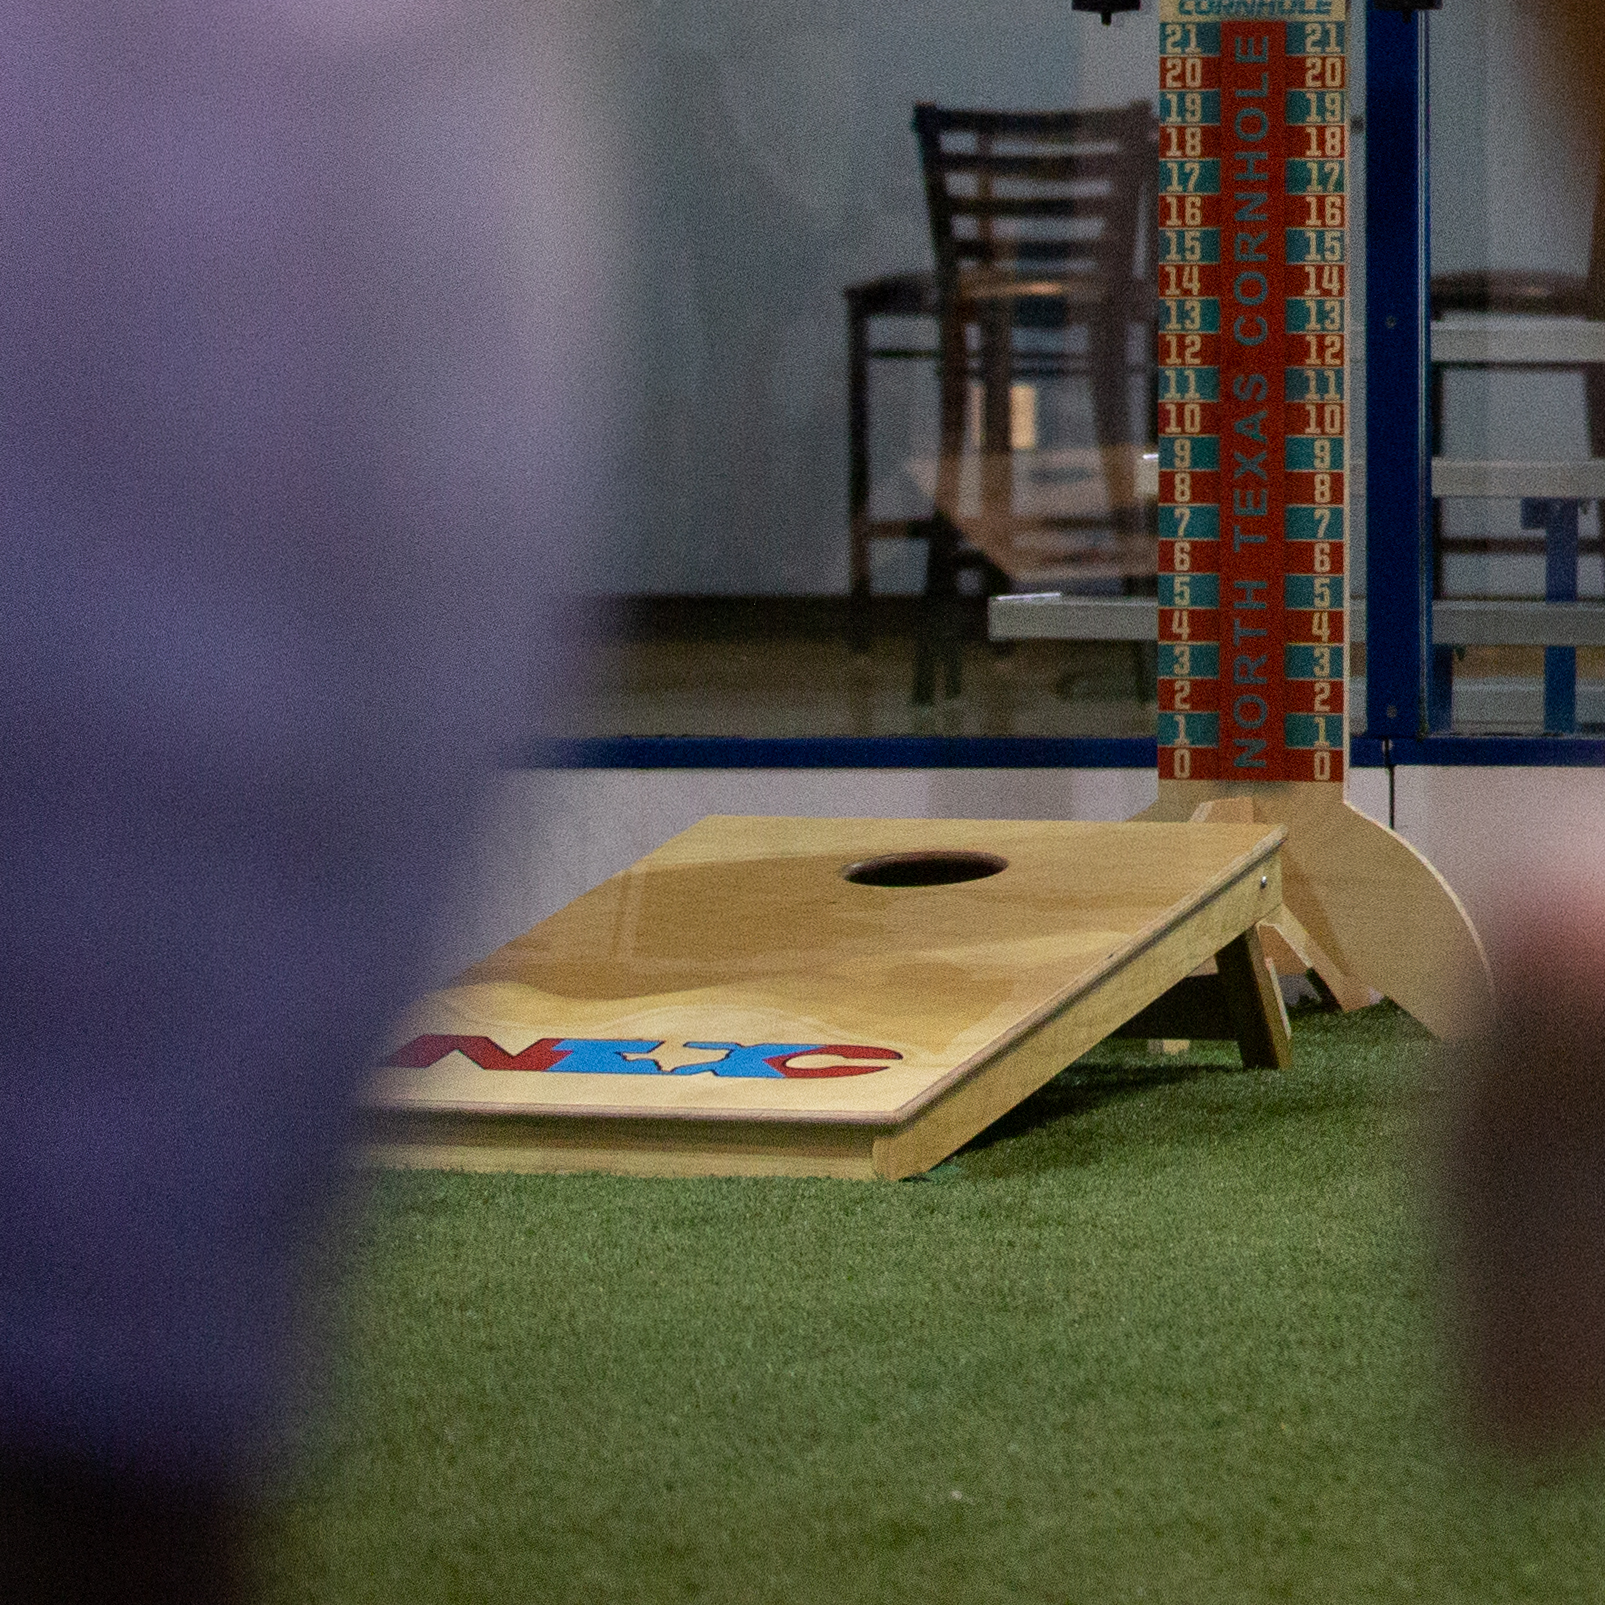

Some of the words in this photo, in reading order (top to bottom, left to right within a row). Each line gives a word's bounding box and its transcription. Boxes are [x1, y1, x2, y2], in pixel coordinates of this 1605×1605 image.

[1165, 25, 1198, 54] 21
[1305, 25, 1339, 54] 21
[1165, 57, 1201, 87] 20
[1305, 57, 1341, 87] 20
[1165, 93, 1201, 122] 19
[1305, 93, 1341, 122] 19
[1165, 127, 1201, 157] 18
[1305, 127, 1341, 157] 18
[1165, 162, 1200, 192] 17
[1234, 36, 1269, 346] CORNHOLE
[1305, 162, 1340, 192] 17
[1165, 196, 1201, 226] 16
[1305, 197, 1341, 227] 16
[1165, 231, 1201, 261] 15
[1305, 232, 1341, 262] 15
[1165, 266, 1201, 296] 14
[1305, 267, 1341, 297] 14
[1165, 300, 1201, 330] 13
[1305, 301, 1341, 331] 13
[1165, 335, 1201, 365] 12
[1305, 336, 1341, 366] 12
[1165, 370, 1198, 400] 11
[1305, 371, 1339, 401] 11
[1165, 404, 1201, 433] 10
[1305, 405, 1341, 434] 10
[1173, 439, 1191, 468] 9
[1233, 374, 1268, 553] TEXAS
[1314, 440, 1330, 469] 9
[1173, 473, 1191, 503] 8
[1314, 475, 1330, 505] 8
[1173, 507, 1191, 536] 7
[1314, 509, 1330, 538] 7
[1173, 541, 1191, 571] 6
[1314, 543, 1330, 573] 6
[1173, 576, 1191, 606] 5
[1314, 578, 1330, 608] 5
[1171, 610, 1191, 640] 4
[1312, 612, 1330, 642] 4
[1173, 645, 1191, 675] 3
[1233, 580, 1268, 768] NORTH
[1314, 647, 1330, 677] 3
[1173, 680, 1191, 710] 2
[1314, 682, 1330, 712] 2
[1173, 715, 1191, 746] 1
[1314, 717, 1330, 748] 1
[1173, 749, 1191, 779] 0
[1314, 752, 1330, 782] 0
